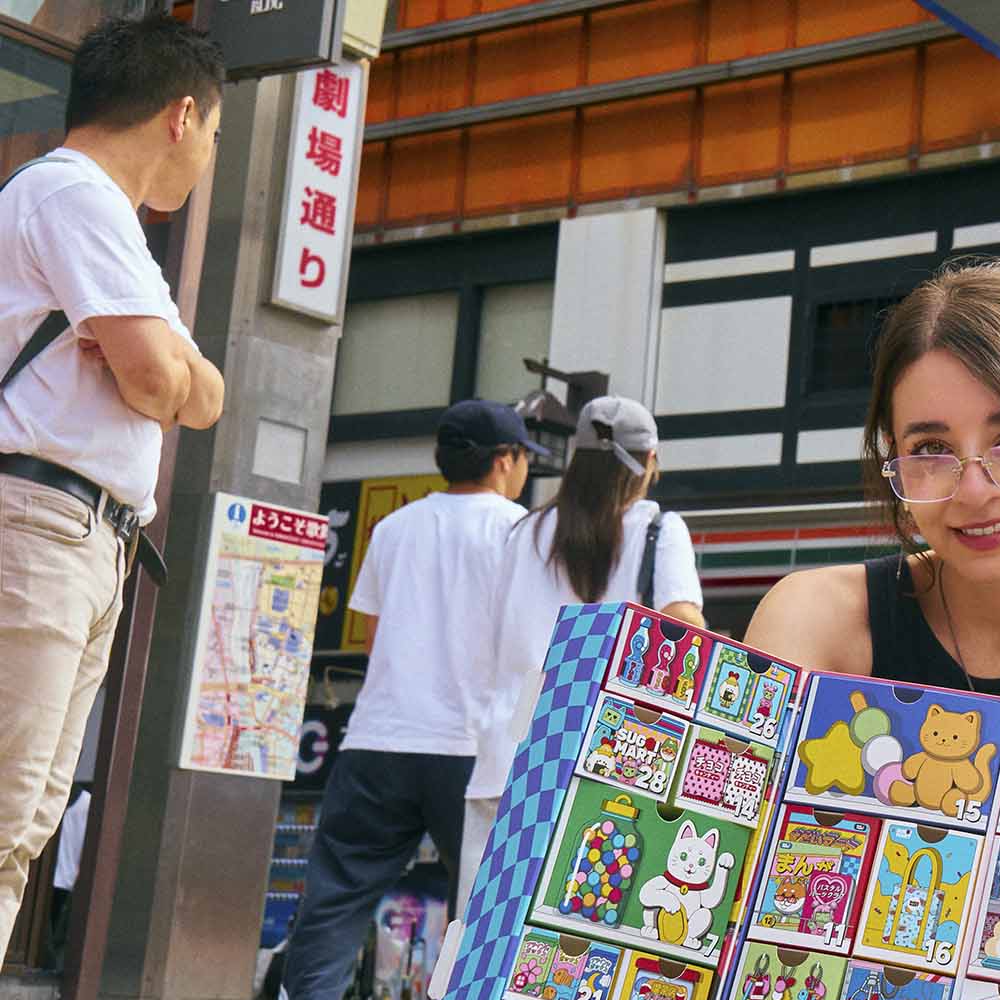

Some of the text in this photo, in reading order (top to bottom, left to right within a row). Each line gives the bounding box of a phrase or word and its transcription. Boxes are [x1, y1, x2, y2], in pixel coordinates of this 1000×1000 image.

[298, 69, 351, 289] 劇場通り
[684, 687, 695, 710] 1
[749, 713, 779, 741] 26
[613, 740, 658, 766] MART
[695, 756, 725, 774] チョコ
[635, 766, 668, 795] 28
[734, 767, 762, 785] チョコ
[734, 795, 758, 821] 14
[955, 799, 982, 823] 15
[775, 853, 835, 877] まんが
[703, 933, 720, 958] 7
[823, 921, 848, 947] 11
[926, 939, 953, 966] 16
